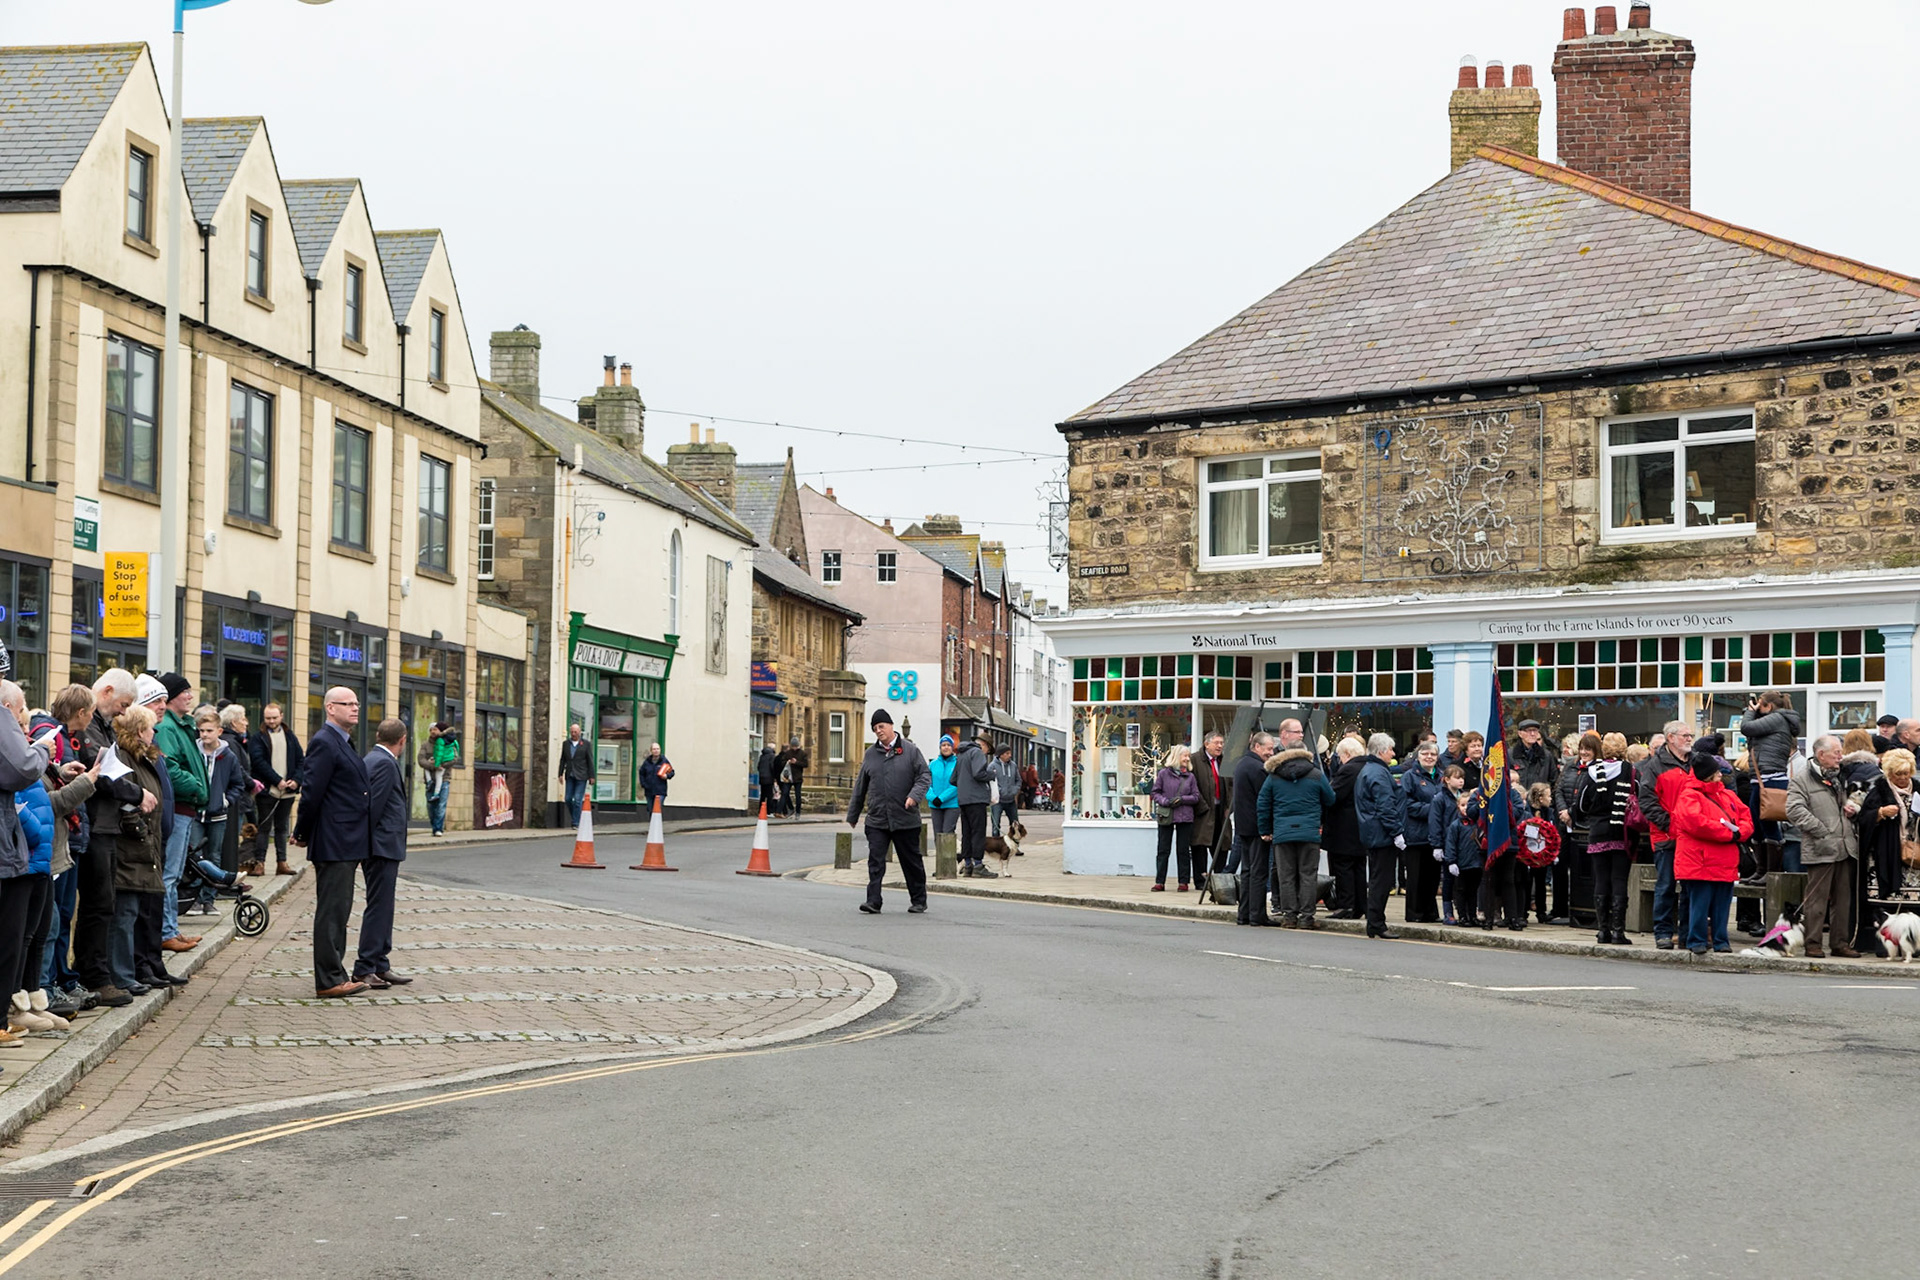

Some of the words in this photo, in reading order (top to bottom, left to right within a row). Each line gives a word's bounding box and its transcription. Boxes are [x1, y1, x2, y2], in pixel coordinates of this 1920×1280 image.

[84, 522, 95, 534] LET
[116, 561, 135, 570] Bus
[1081, 566, 1110, 576] SEAFIELD
[1110, 565, 1128, 574] ROAD
[113, 571, 137, 582] Stop
[116, 583, 134, 591] out
[108, 591, 119, 602] of
[122, 593, 141, 602] use
[1488, 622, 1524, 636] Caring
[1526, 621, 1541, 633] for
[1544, 620, 1561, 632] the
[1563, 619, 1594, 632] Farne
[1596, 616, 1634, 630] Islands
[1637, 616, 1653, 628] for
[1656, 617, 1681, 628] over
[1683, 614, 1700, 626] 90
[1702, 614, 1734, 629] years
[1203, 633, 1248, 648] National
[1249, 633, 1277, 646] Trust
[576, 644, 603, 665] POLKA
[603, 650, 620, 668] DOT
